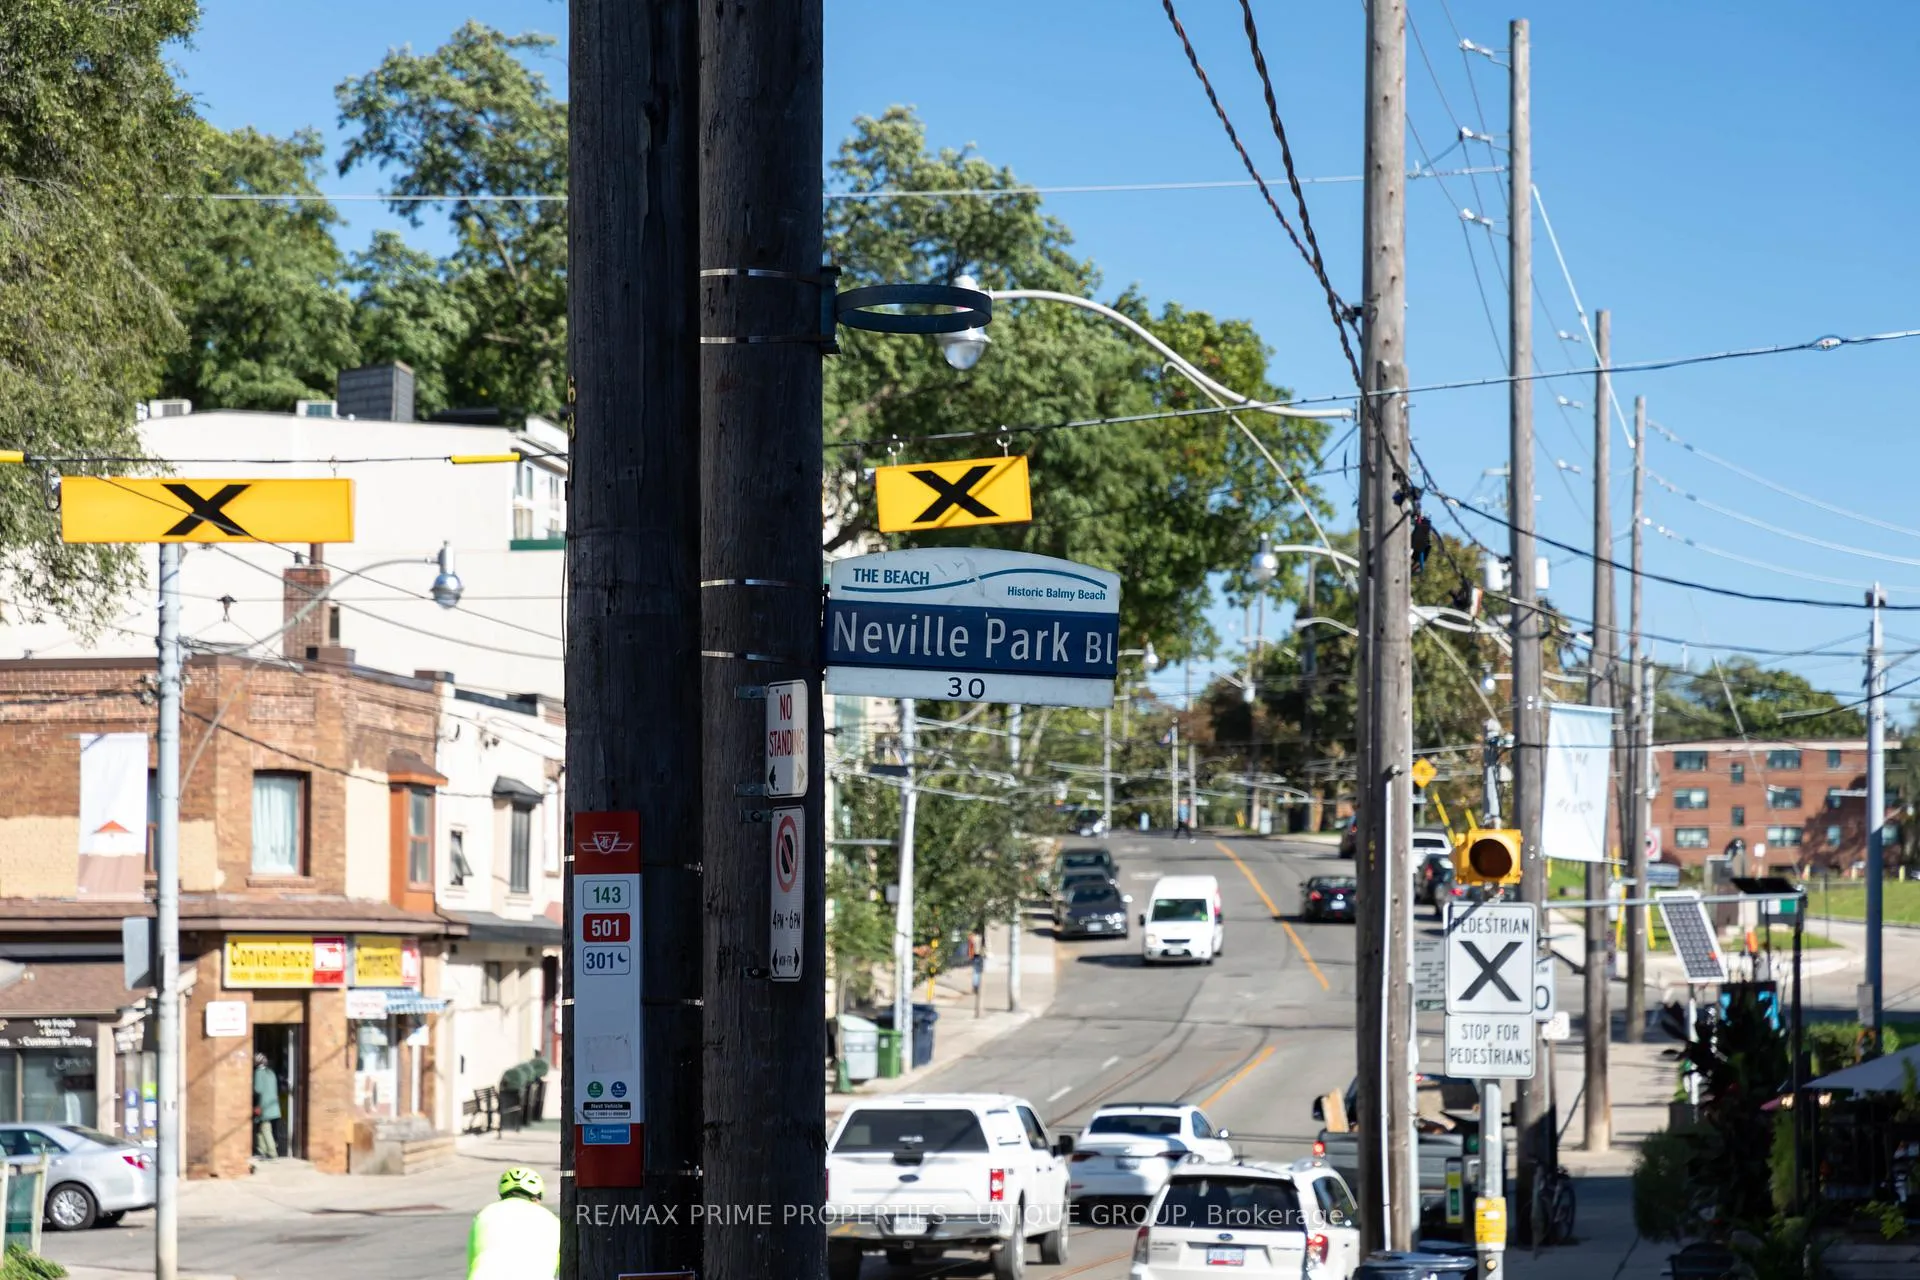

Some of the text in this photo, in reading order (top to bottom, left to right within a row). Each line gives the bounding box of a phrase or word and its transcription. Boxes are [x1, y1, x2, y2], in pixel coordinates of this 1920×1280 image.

[852, 567, 930, 585] THE BEACH
[1007, 585, 1107, 601] Historic Balmy Beach
[833, 610, 1113, 665] Neville Park Bl
[947, 676, 986, 699] 30
[780, 693, 792, 720] NO
[769, 728, 805, 758] STANDING
[593, 886, 622, 904] 143
[591, 919, 621, 937] 501
[1453, 917, 1529, 934] PEDESTRIAN
[231, 942, 311, 967] Convenience
[586, 952, 614, 969] 301
[1461, 1024, 1519, 1041] STOP FOR
[1450, 1048, 1531, 1065] PEDESTRIANS
